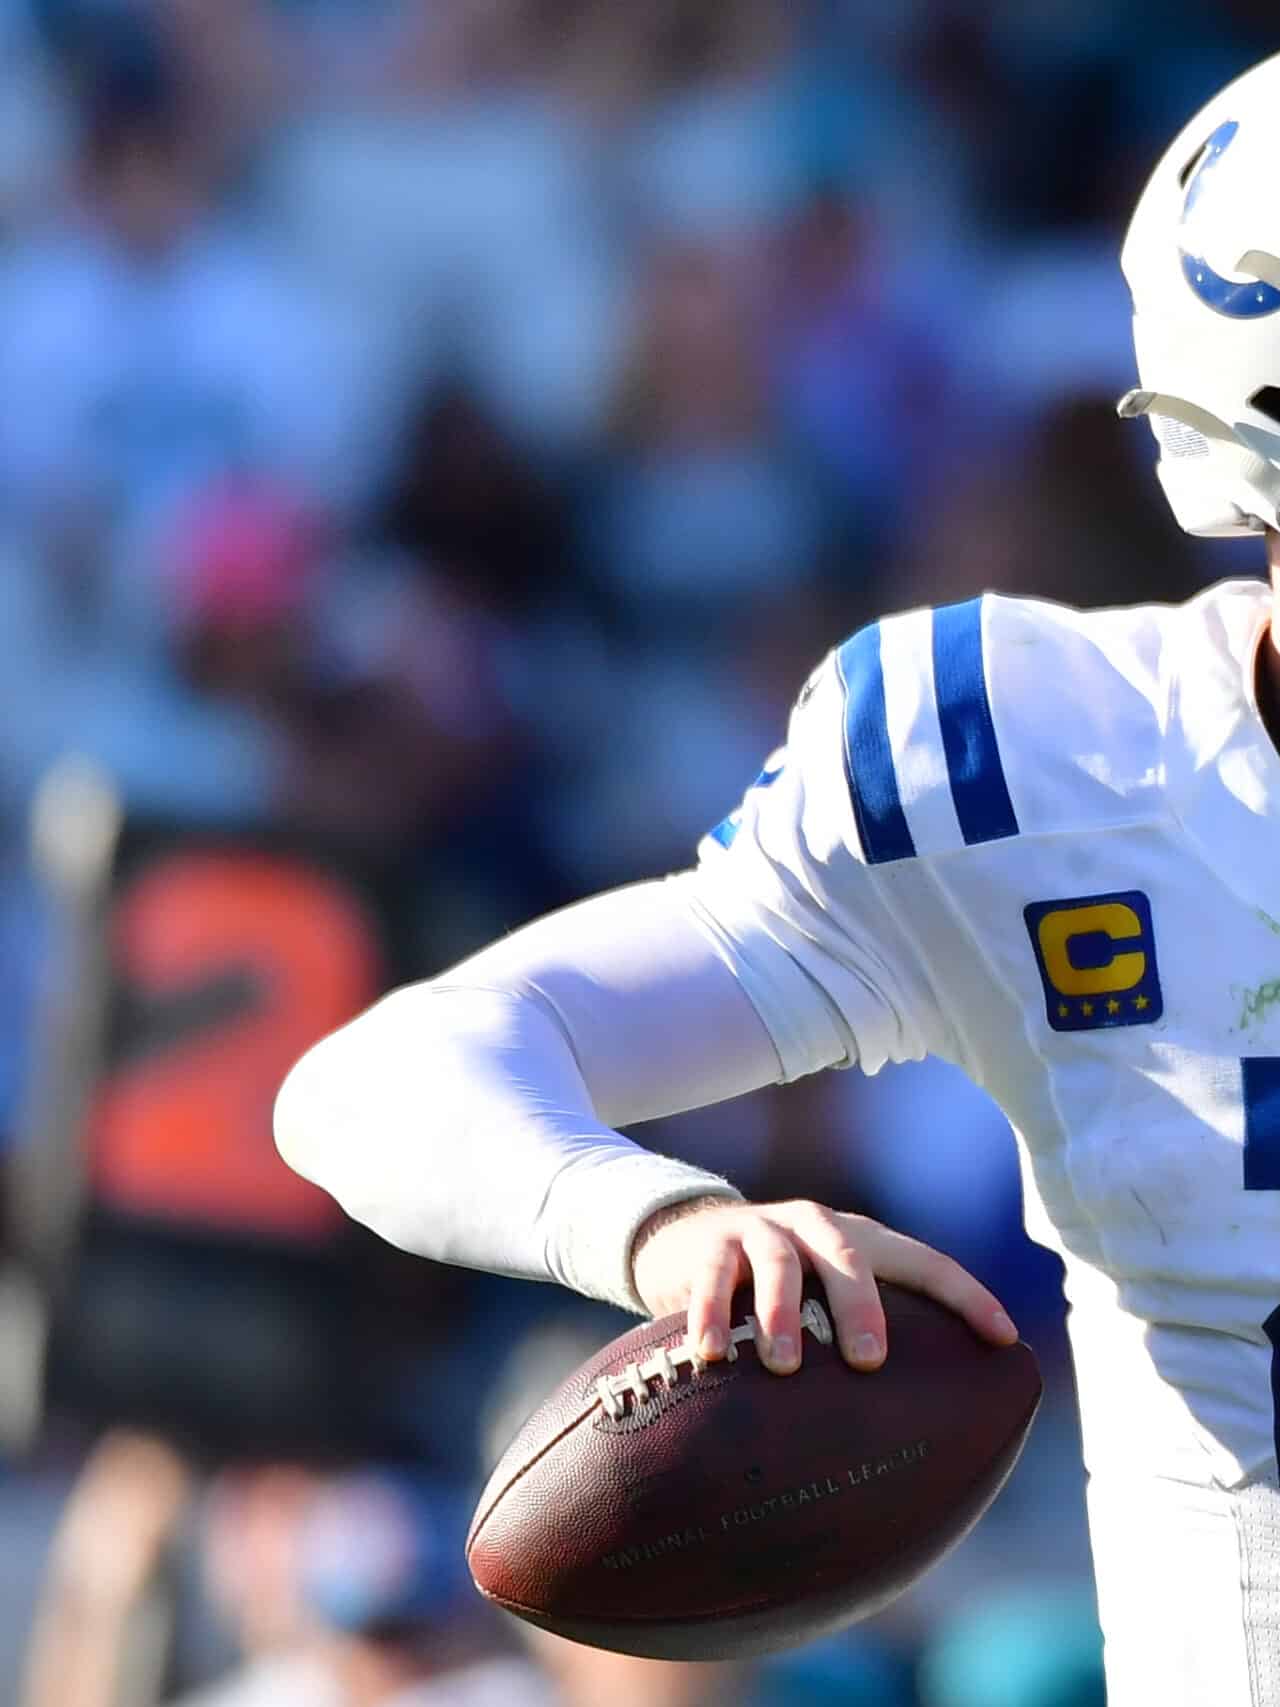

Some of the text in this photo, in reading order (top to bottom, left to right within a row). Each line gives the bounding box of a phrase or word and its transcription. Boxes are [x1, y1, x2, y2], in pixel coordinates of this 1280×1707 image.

[1038, 903, 1146, 996] C
[88, 846, 380, 1240] 2
[601, 1526, 706, 1569] NATIONAL
[719, 1477, 840, 1531] FOOTBALL
